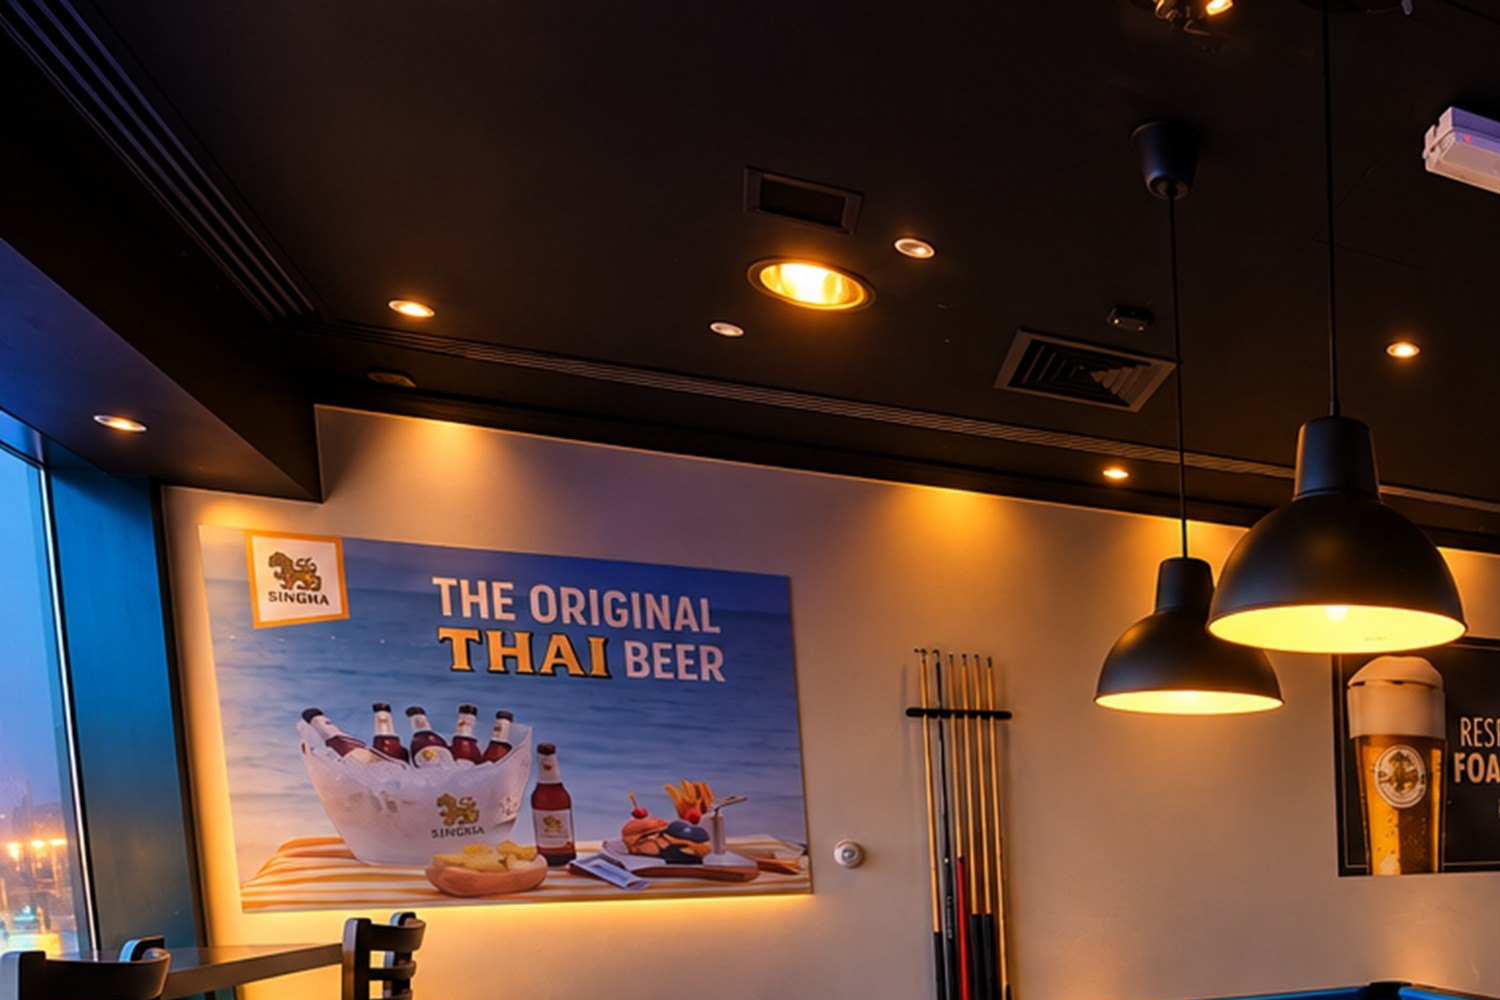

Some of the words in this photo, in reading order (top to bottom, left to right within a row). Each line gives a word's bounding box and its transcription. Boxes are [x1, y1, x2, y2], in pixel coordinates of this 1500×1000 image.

[268, 591, 329, 606] SINGHA
[432, 577, 516, 621] THE
[529, 584, 720, 633] ORIGINAL
[437, 627, 612, 679] THAI
[624, 640, 726, 682] BEER
